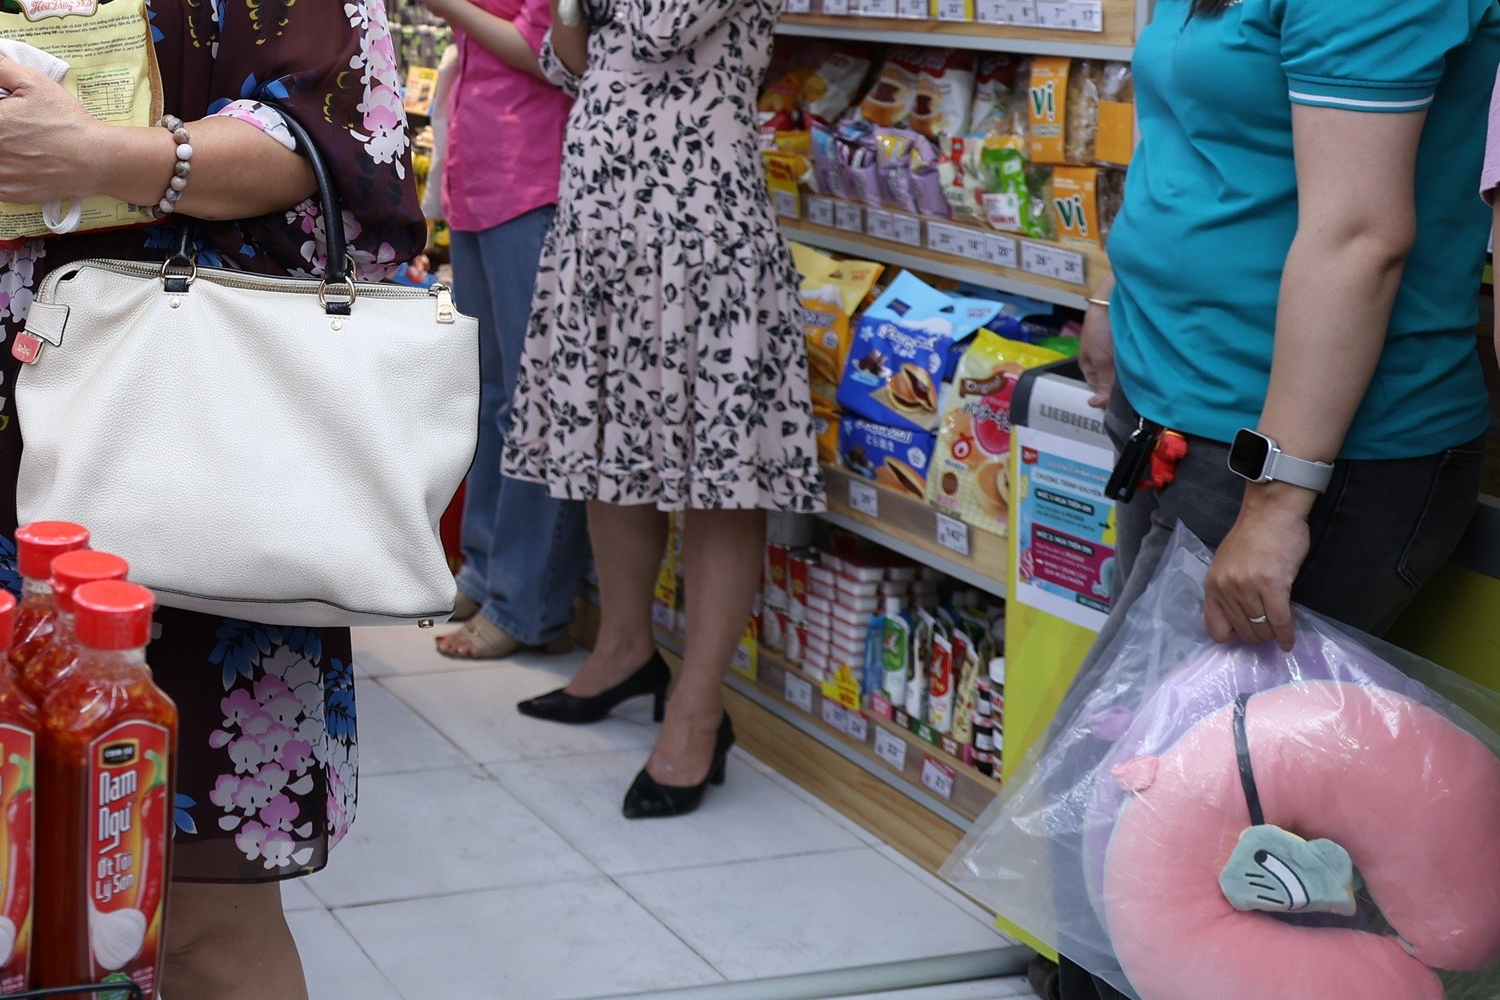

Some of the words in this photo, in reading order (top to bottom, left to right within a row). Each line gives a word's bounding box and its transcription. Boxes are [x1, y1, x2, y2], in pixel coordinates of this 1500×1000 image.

[1031, 81, 1055, 121] Vị
[1055, 194, 1087, 236] Vị
[99, 770, 137, 806] Nam
[99, 802, 133, 855] Ngư
[97, 857, 113, 879] Ớt
[114, 852, 133, 873] Tỏi
[96, 880, 112, 902] Lý
[113, 873, 134, 894] Sơn
